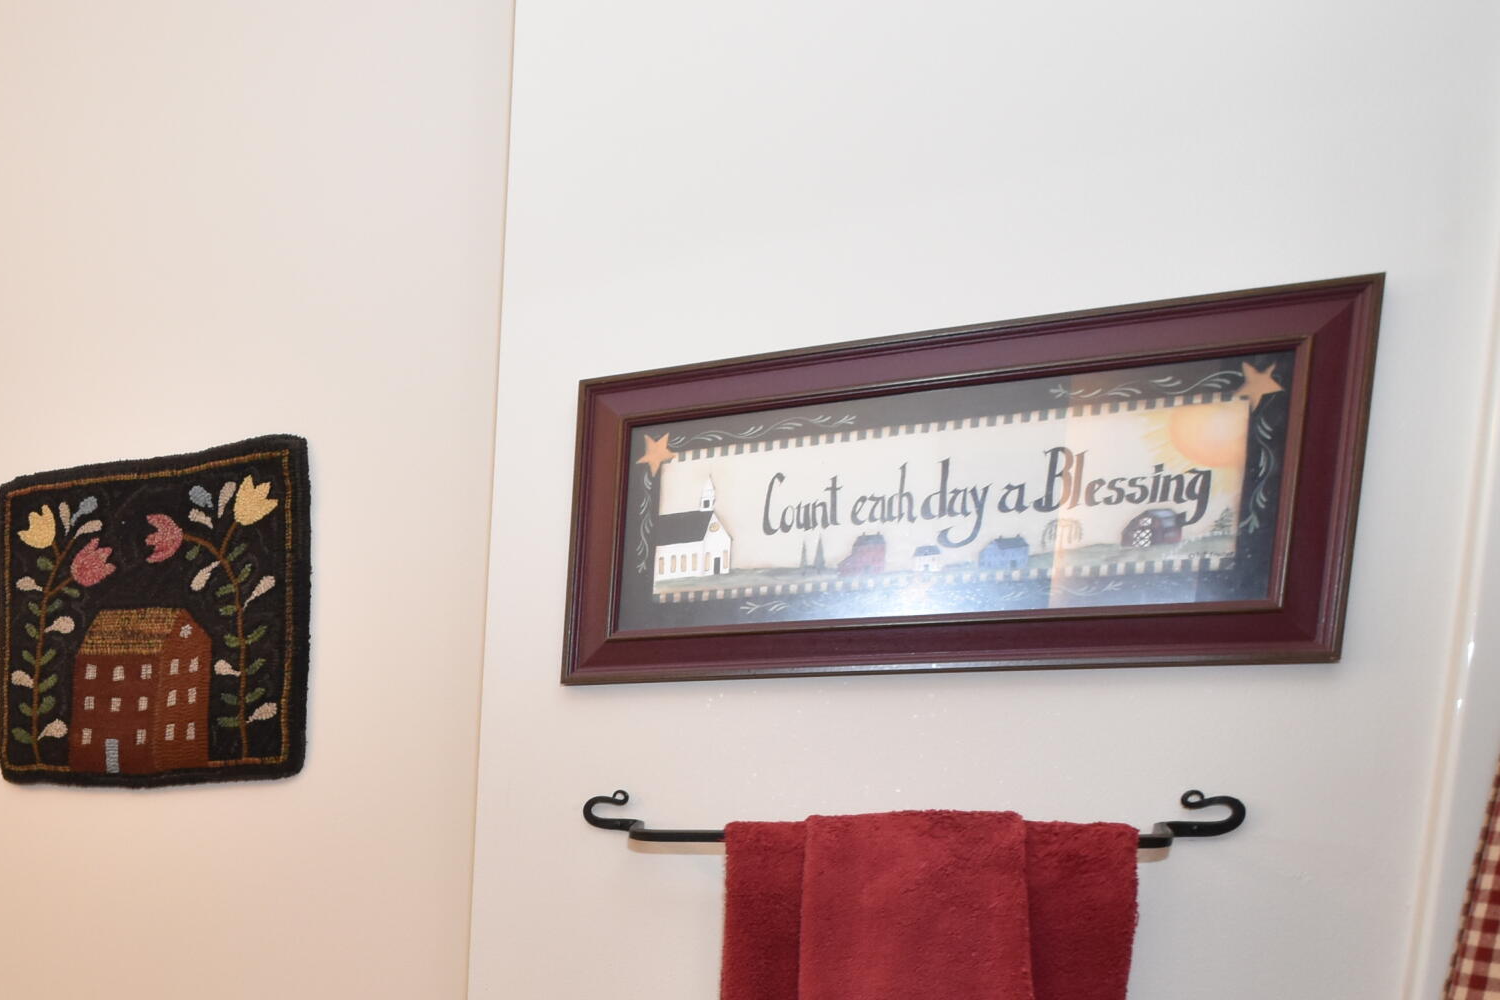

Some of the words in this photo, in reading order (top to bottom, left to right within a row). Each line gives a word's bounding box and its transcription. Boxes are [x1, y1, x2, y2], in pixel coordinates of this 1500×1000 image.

[762, 471, 842, 535] Count
[850, 461, 918, 524] each
[920, 458, 990, 547] day
[999, 483, 1032, 513] a
[1033, 446, 1212, 526] Blessing
